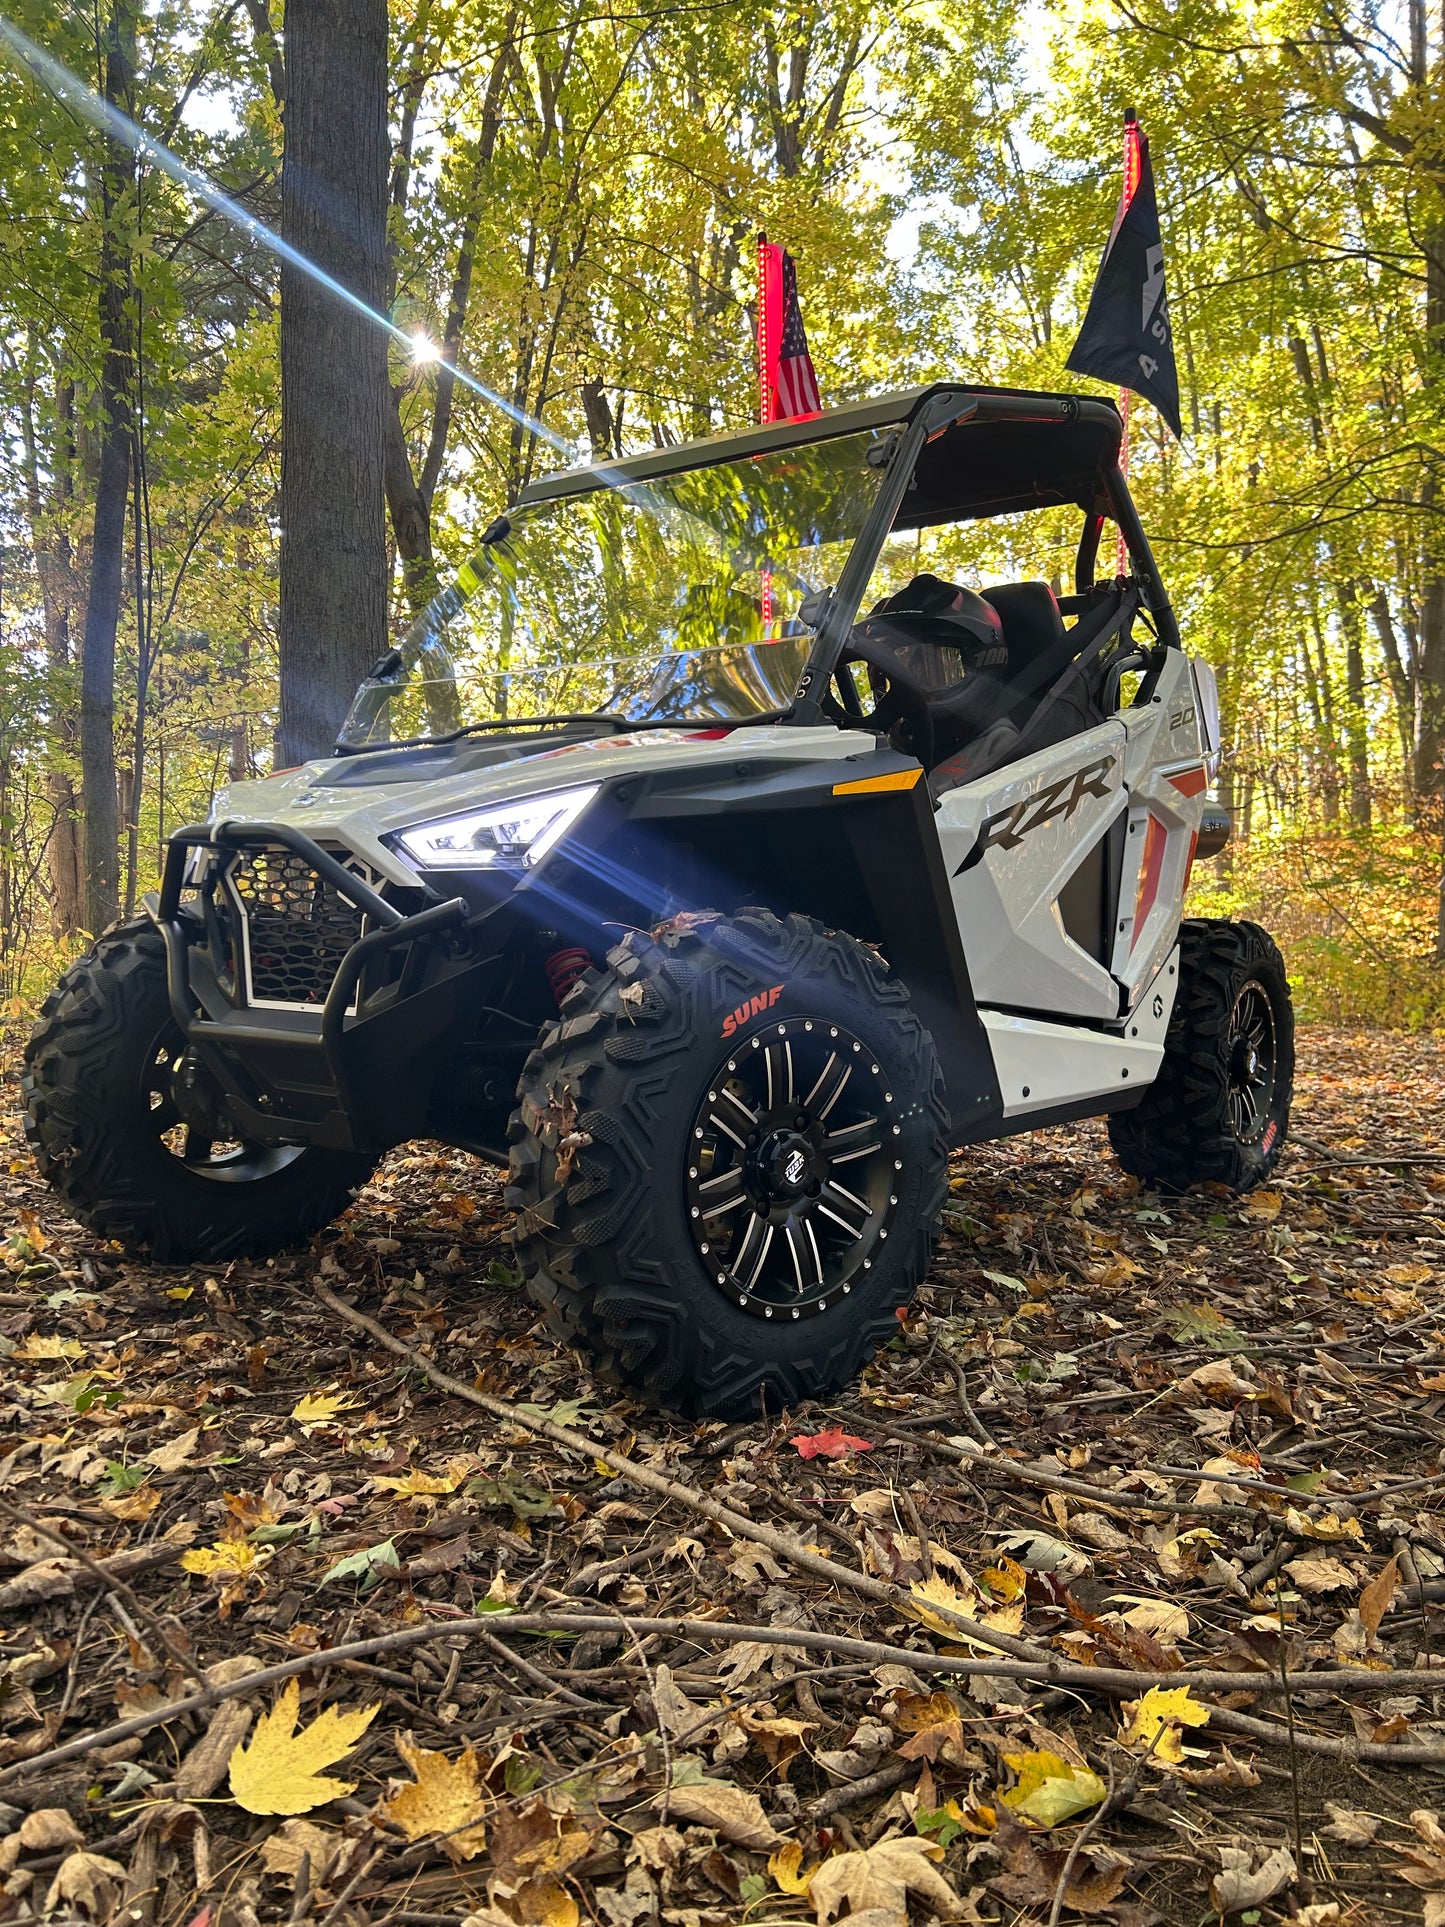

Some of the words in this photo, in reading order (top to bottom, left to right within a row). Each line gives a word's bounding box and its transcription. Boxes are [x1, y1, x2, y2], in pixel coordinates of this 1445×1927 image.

[952, 755, 1117, 878] RZR
[720, 984, 785, 1039] SUNF
[785, 1155, 805, 1178] TUSK
